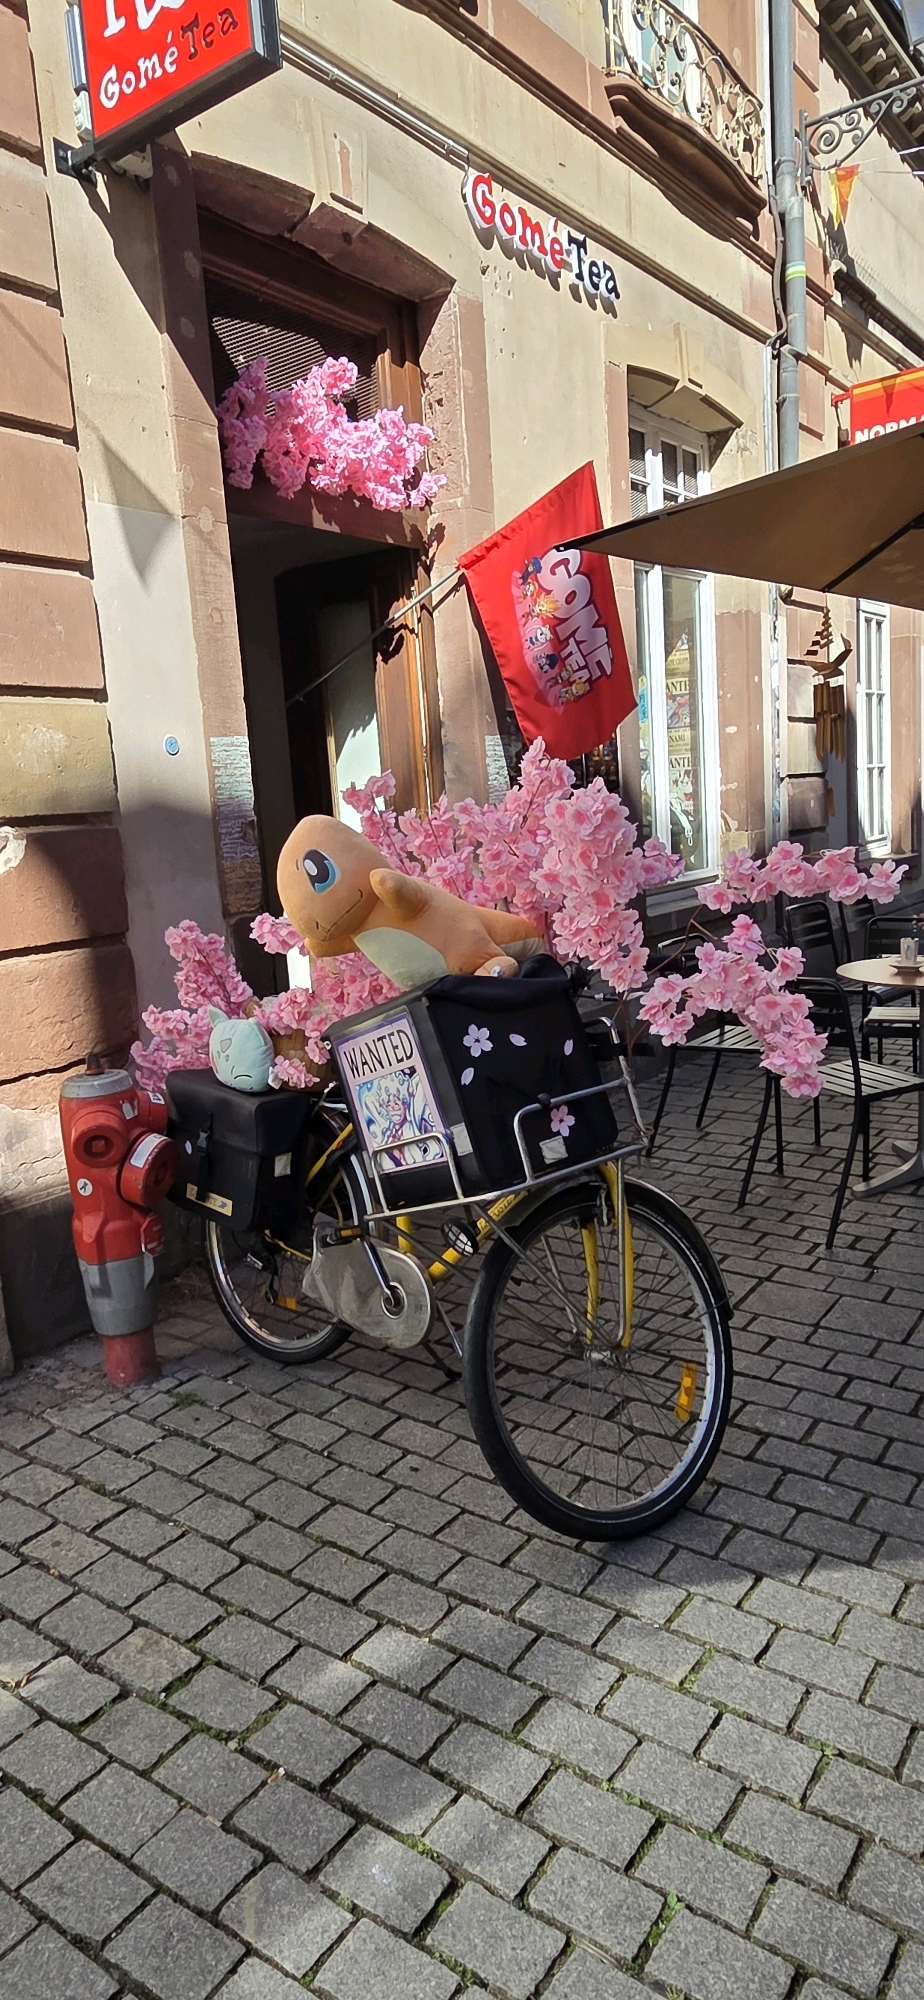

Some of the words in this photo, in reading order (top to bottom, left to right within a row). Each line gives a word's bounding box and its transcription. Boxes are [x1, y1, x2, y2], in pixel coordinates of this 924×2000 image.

[100, 30, 178, 109] Gomé
[180, 8, 239, 61] Tea
[467, 173, 564, 271] Gomé
[563, 229, 620, 302] Tea
[343, 1029, 414, 1079] WANTED
